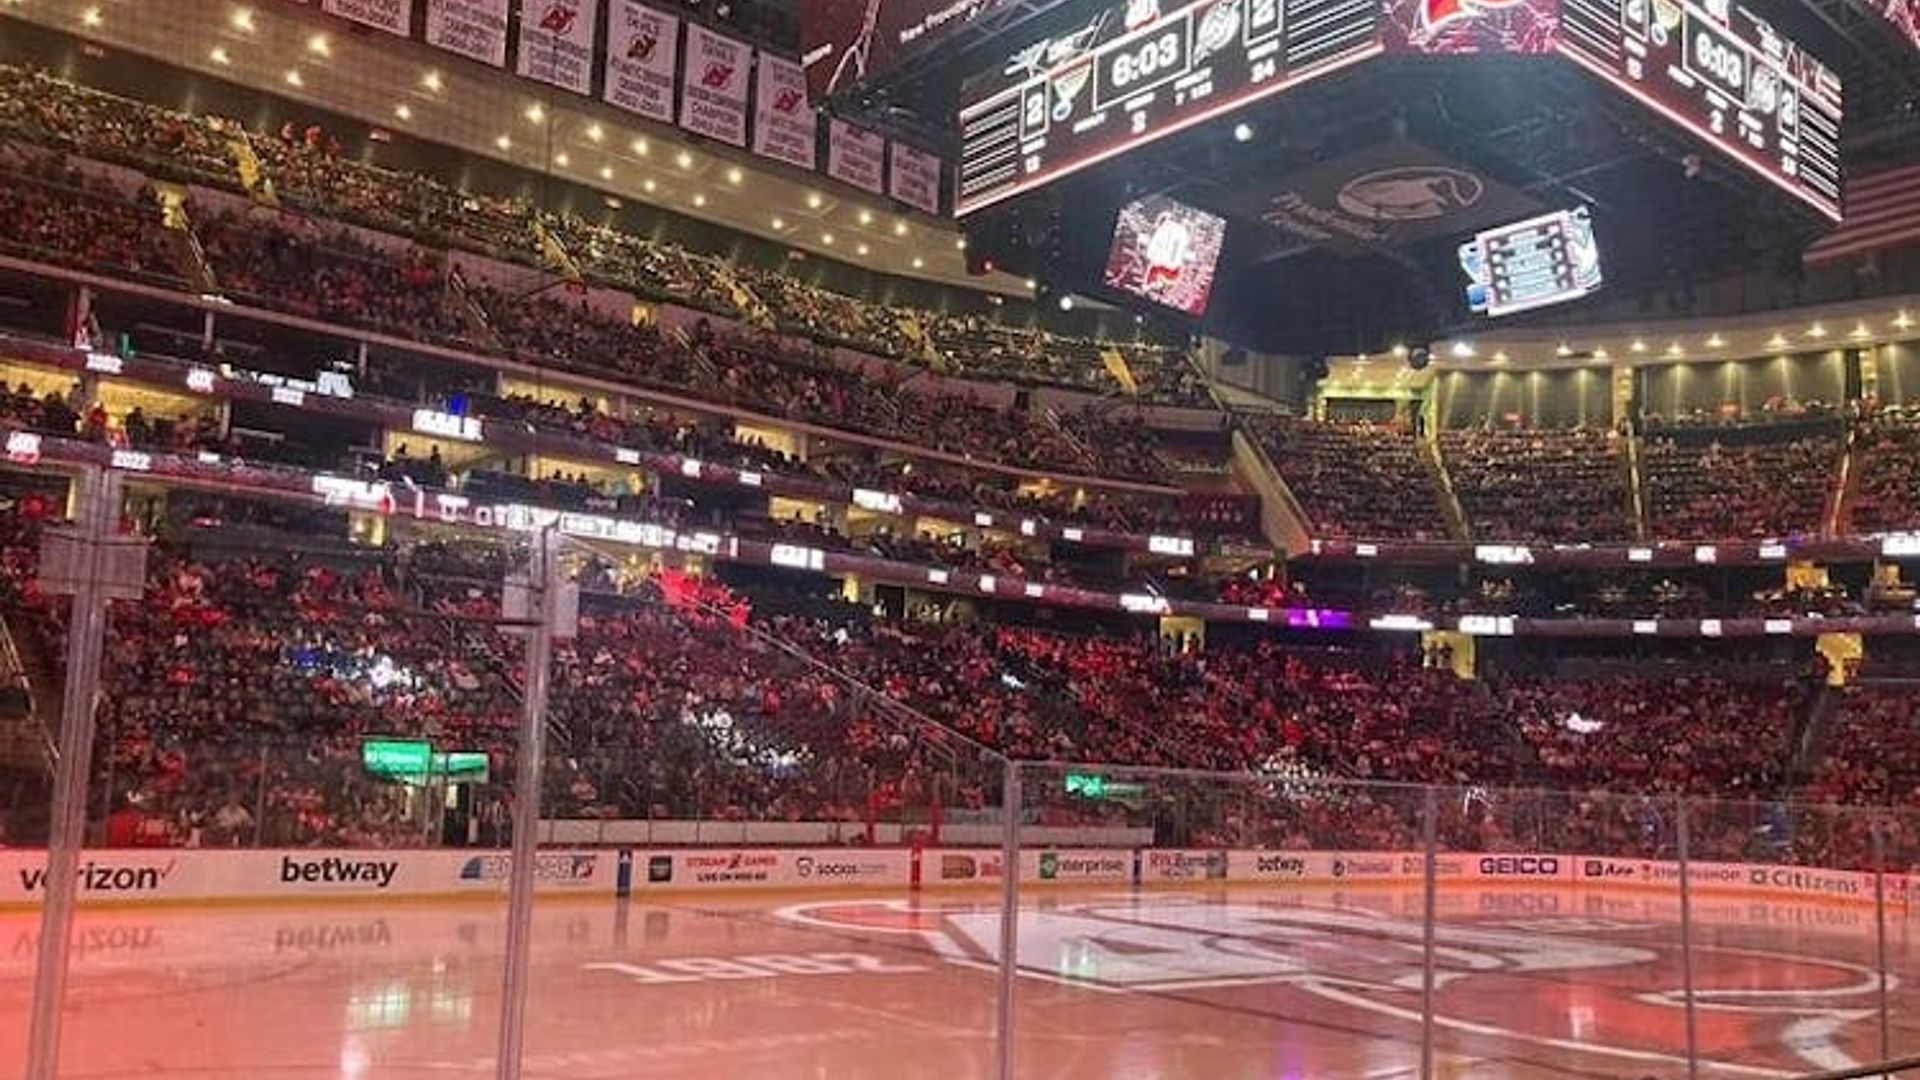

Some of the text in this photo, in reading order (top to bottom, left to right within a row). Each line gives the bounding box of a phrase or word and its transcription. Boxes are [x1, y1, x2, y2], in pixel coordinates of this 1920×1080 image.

[281, 856, 398, 888] betway
[1257, 855, 1305, 875] betway
[1479, 857, 1558, 874] GEICO
[1771, 869, 1859, 894] Citizens
